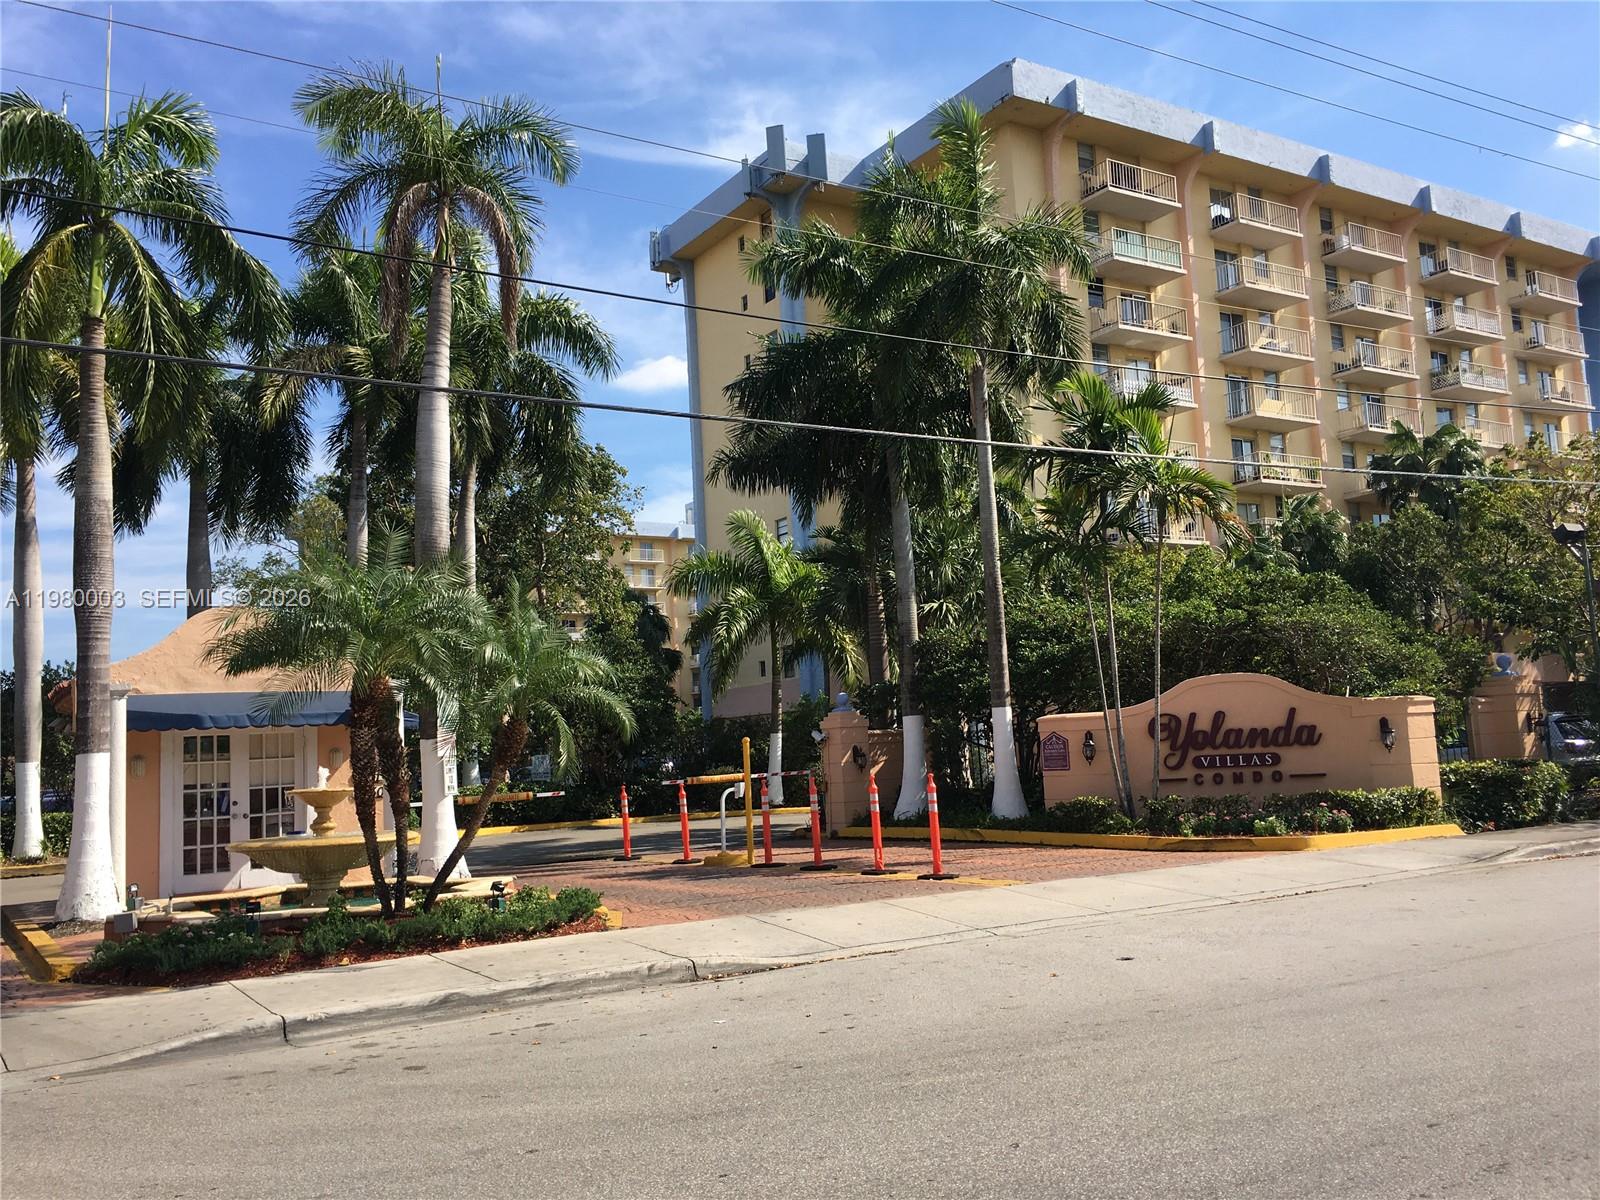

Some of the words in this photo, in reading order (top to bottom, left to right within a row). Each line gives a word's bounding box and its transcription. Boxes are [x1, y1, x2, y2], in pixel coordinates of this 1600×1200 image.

[1148, 707, 1323, 770] Yolanda
[1200, 753, 1273, 768] VILLAS
[1193, 770, 1284, 786] CONDO
